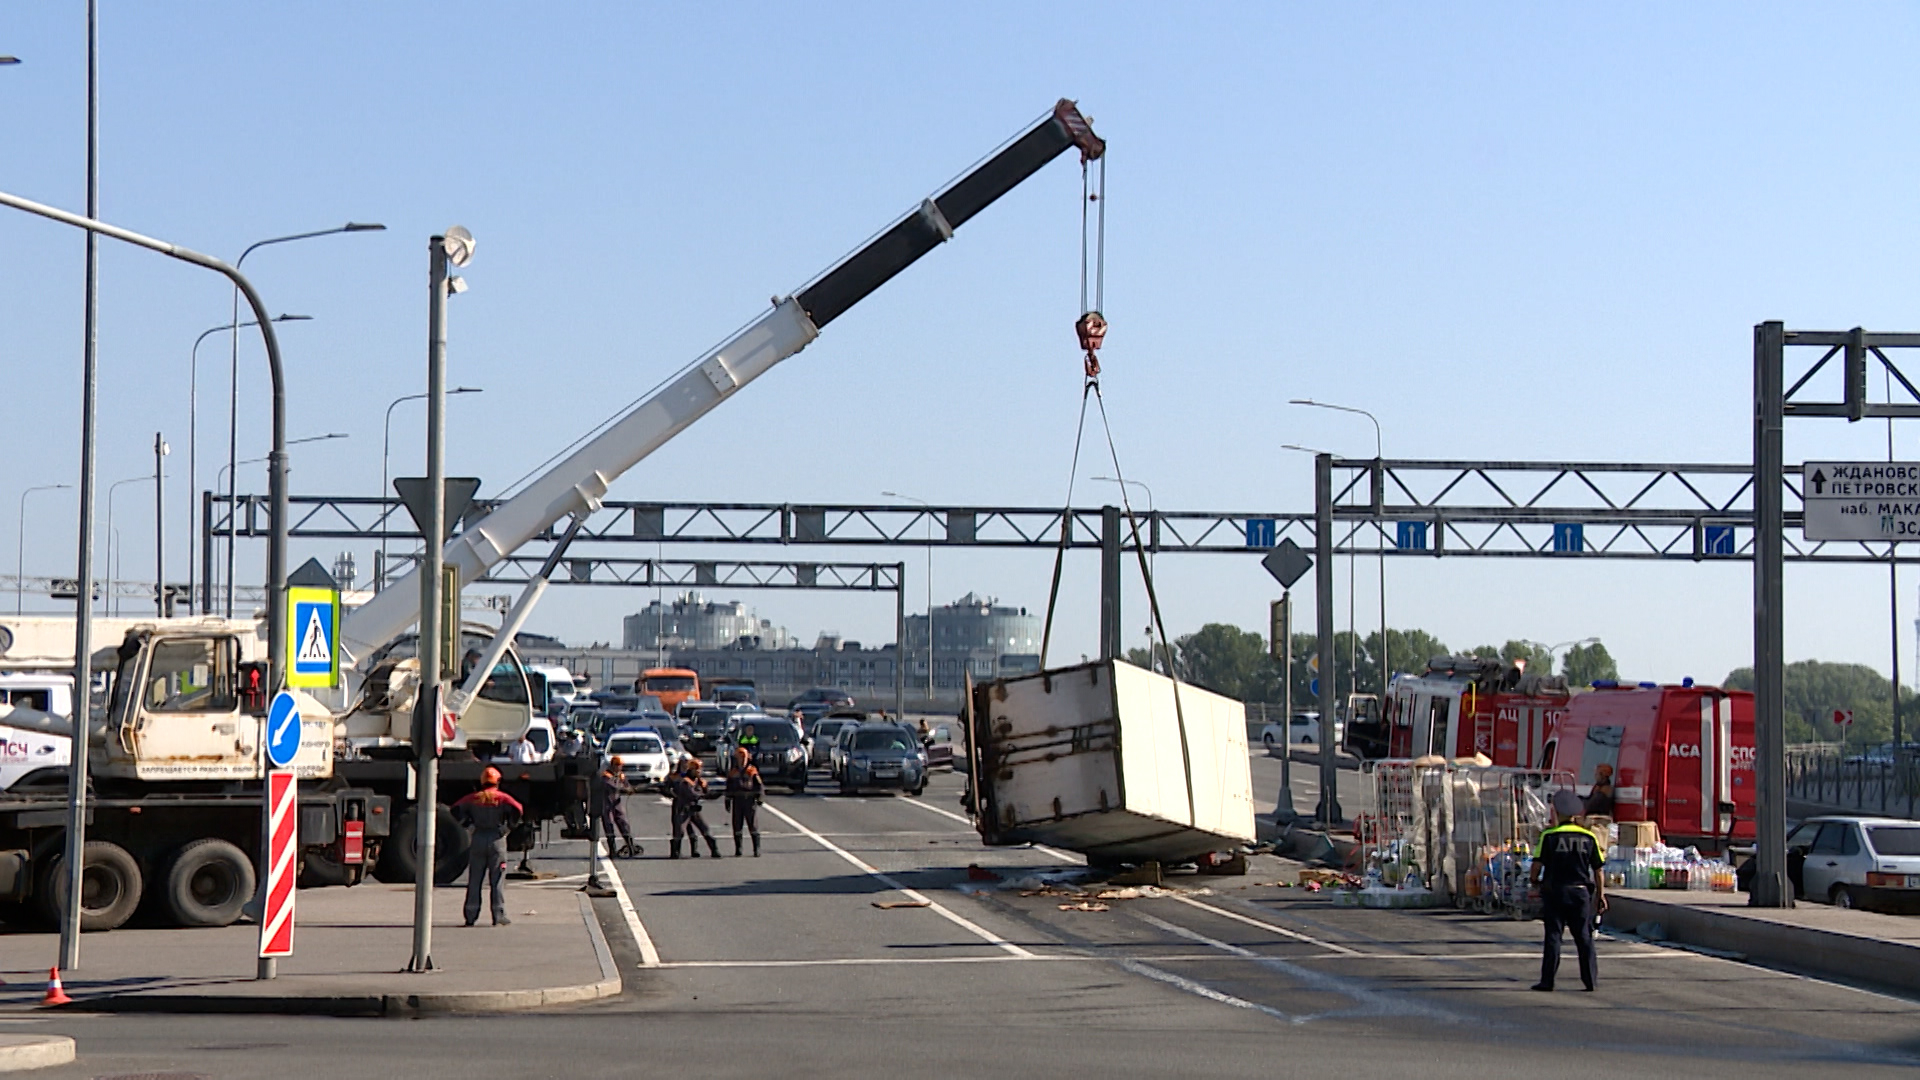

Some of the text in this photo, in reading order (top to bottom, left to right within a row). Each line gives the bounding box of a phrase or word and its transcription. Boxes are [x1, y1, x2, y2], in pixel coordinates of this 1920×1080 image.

[1832, 466, 1920, 480] ЖДАНОВС
[1832, 482, 1920, 496] ПЕТРОВСК
[1840, 501, 1872, 515] наб.
[1897, 521, 1920, 535] ЗС
[1498, 709, 1518, 722] АЦ
[1669, 743, 1700, 758] АСА
[1555, 837, 1589, 853] ДПС
